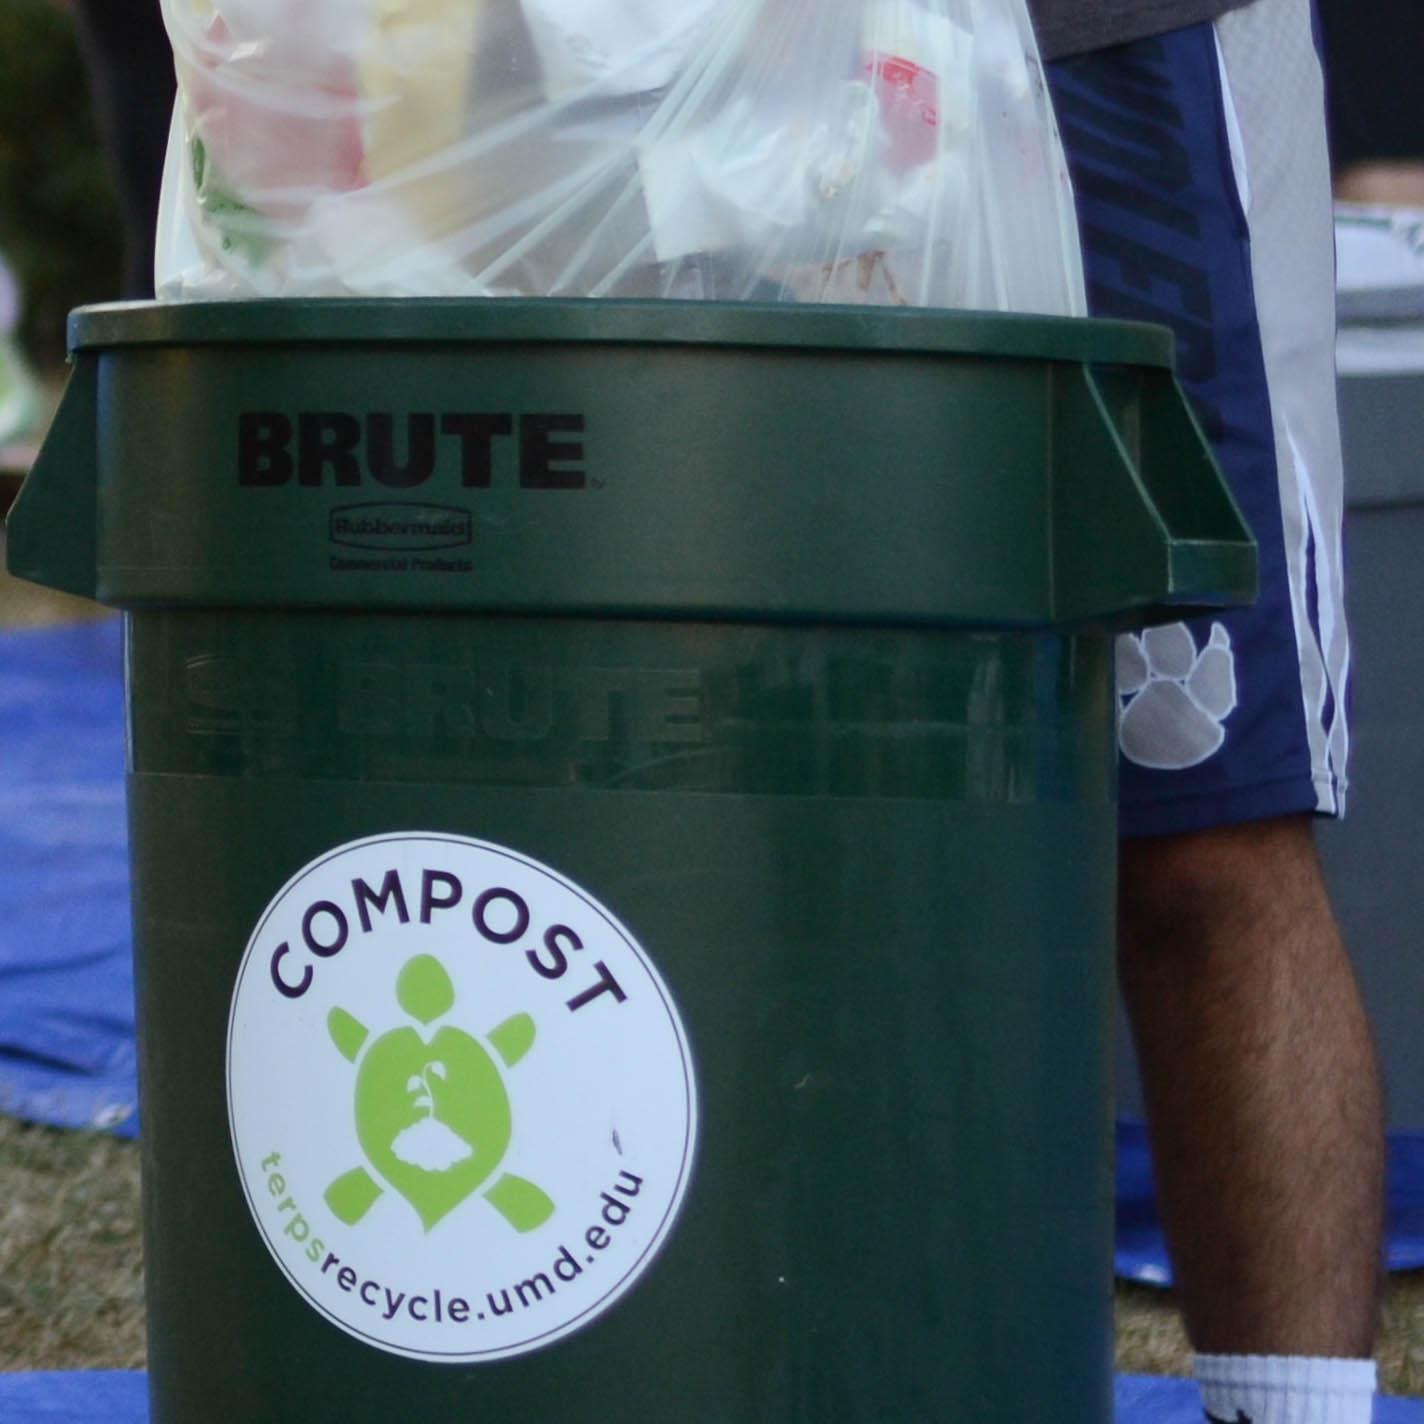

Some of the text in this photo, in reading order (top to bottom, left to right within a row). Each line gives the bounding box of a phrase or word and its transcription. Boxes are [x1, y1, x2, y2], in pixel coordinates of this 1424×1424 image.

[238, 411, 588, 490] BRUTE
[334, 516, 467, 538] Rubbermaid
[269, 868, 628, 1013] COMPOST
[260, 1150, 645, 1324] terpsrecycle.umd.edu
